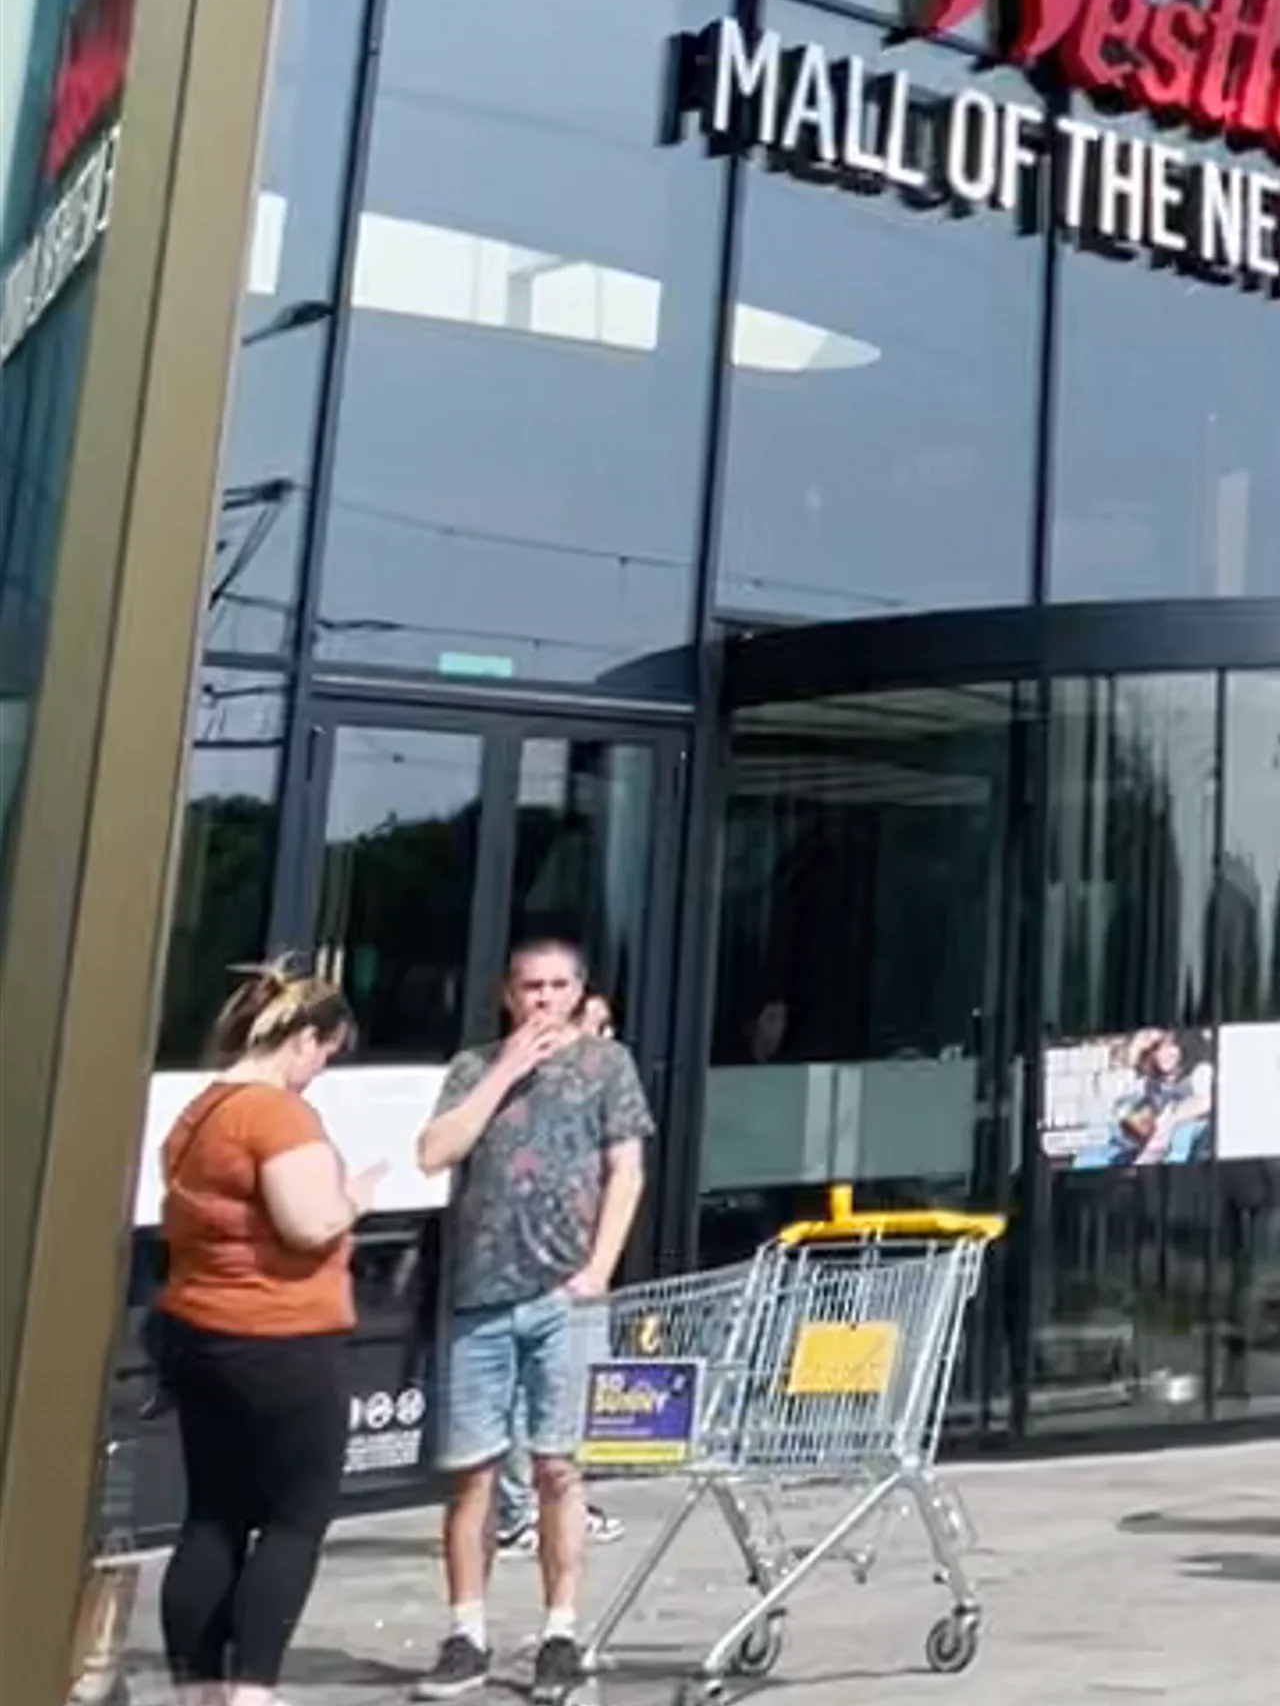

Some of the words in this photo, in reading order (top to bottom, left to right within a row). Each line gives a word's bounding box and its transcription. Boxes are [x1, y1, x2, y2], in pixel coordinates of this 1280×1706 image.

[713, 16, 927, 186] MALL
[947, 87, 1044, 211] OF
[1057, 118, 1187, 251] THE
